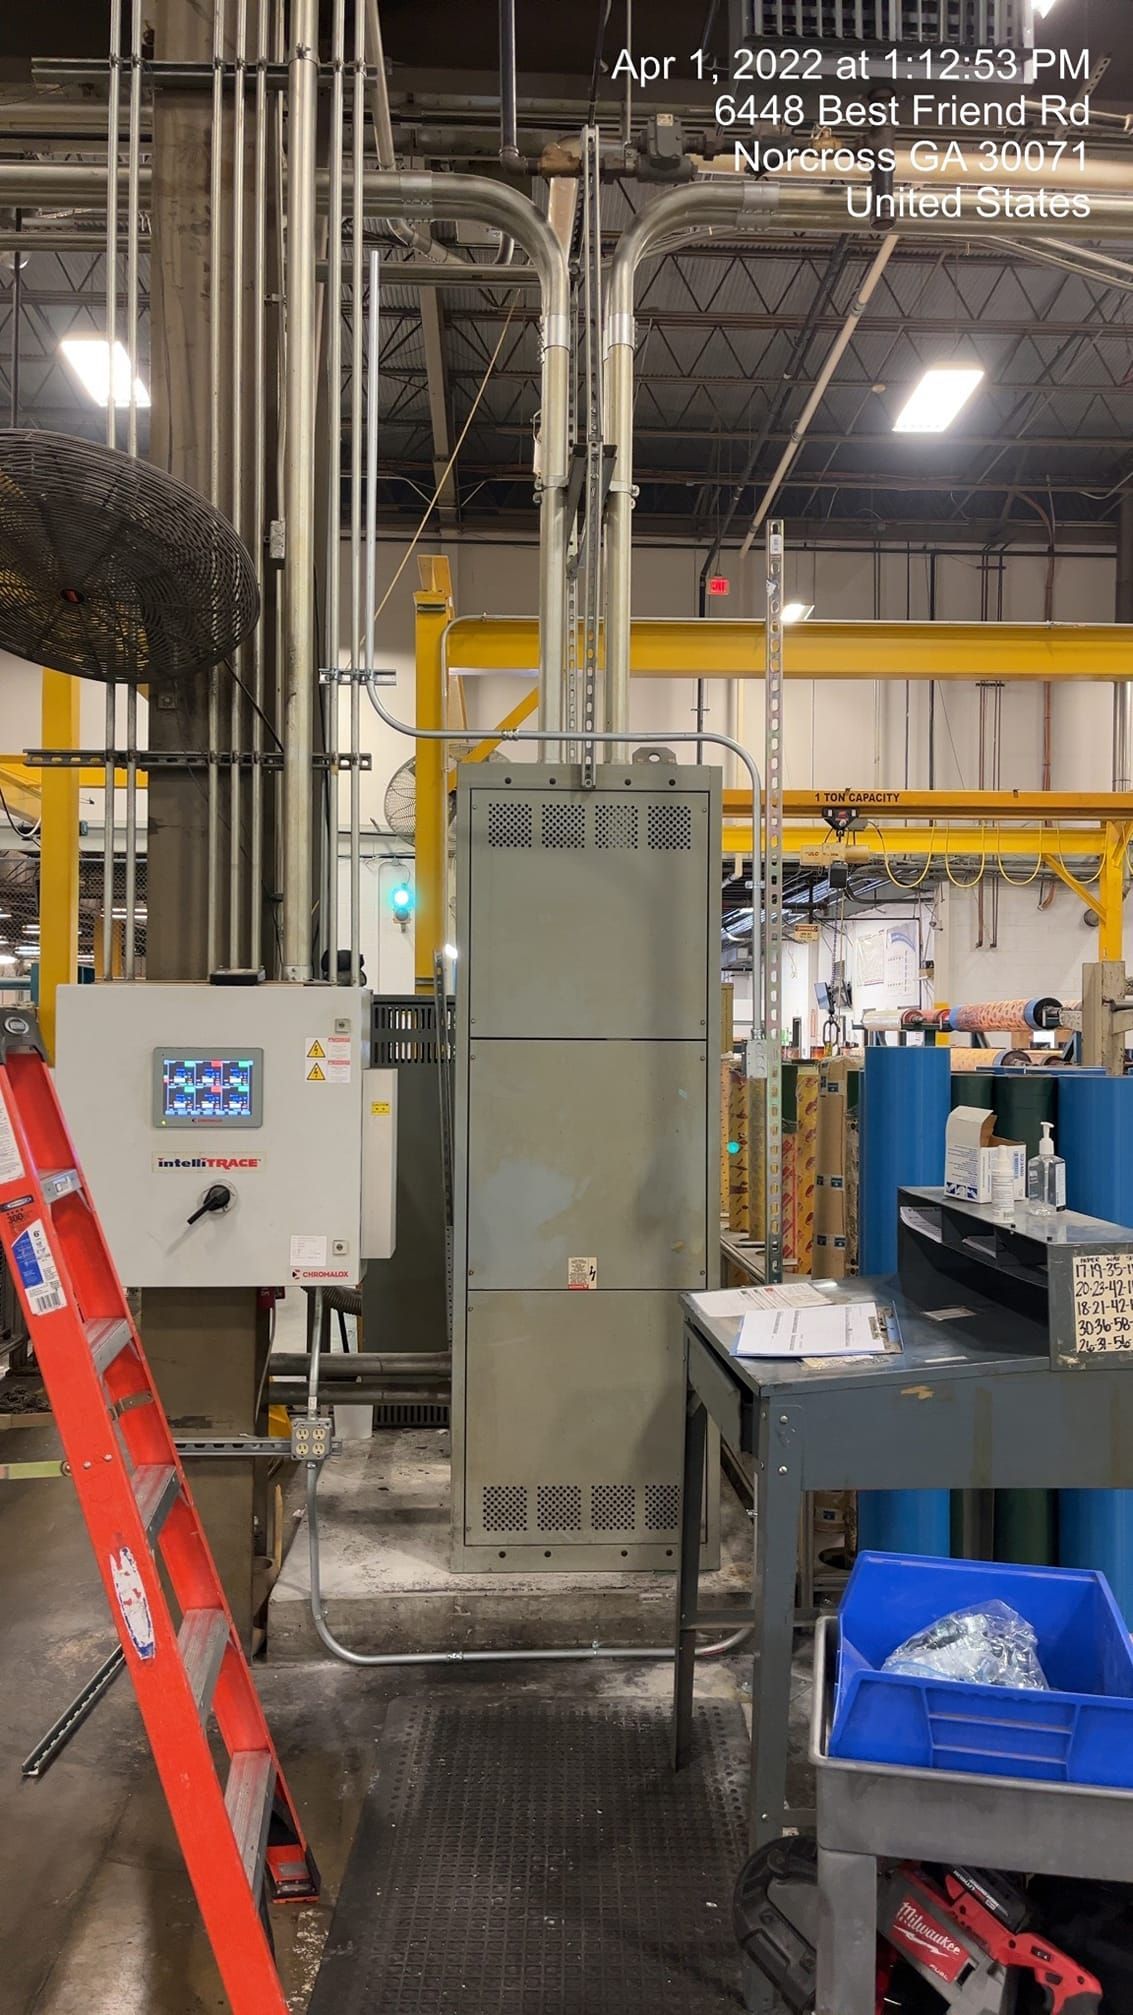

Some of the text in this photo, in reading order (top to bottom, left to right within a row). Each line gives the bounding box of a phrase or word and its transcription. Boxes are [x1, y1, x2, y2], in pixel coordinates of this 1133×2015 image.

[815, 792, 900, 802] 1 TON CAPACITY
[896, 1901, 961, 1956] Milwaukee
